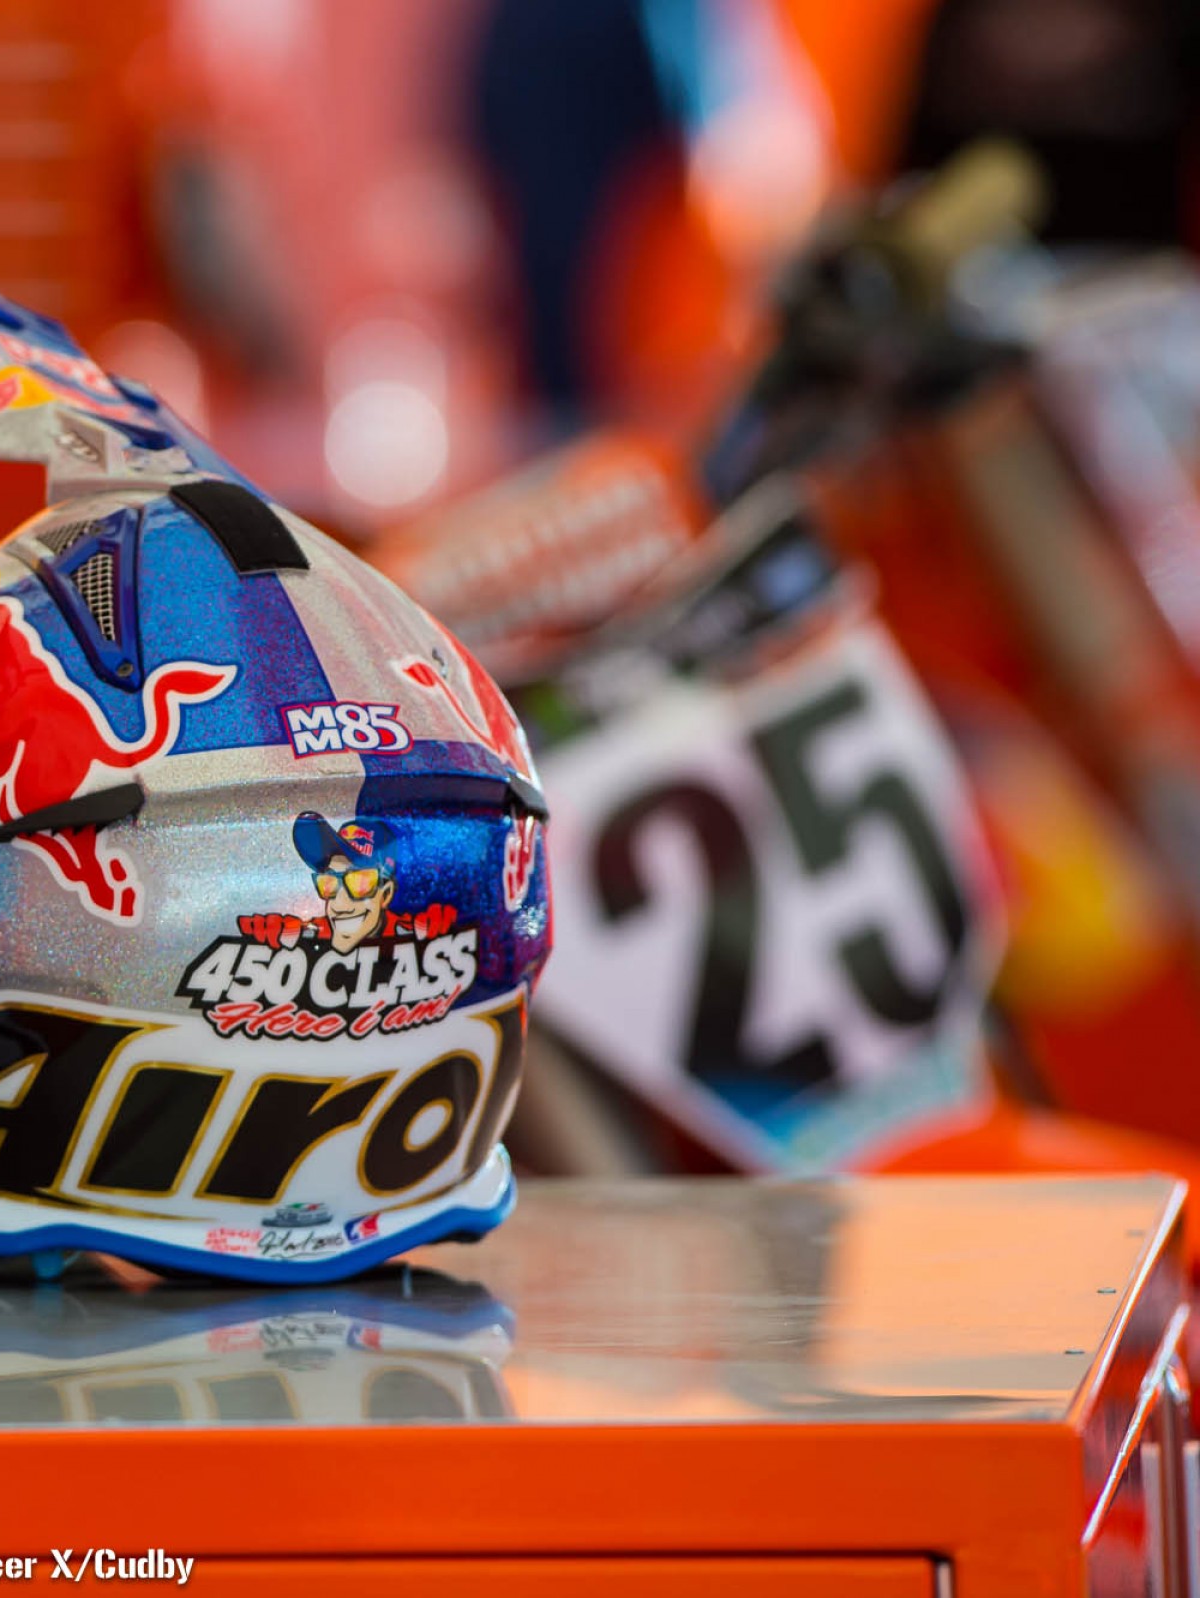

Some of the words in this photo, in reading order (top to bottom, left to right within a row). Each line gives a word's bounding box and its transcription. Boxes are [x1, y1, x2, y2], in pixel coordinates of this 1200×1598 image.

[588, 678, 967, 1096] 25
[186, 942, 308, 1004] 450
[309, 929, 478, 1009] CLASS
[209, 1001, 346, 1036] Here
